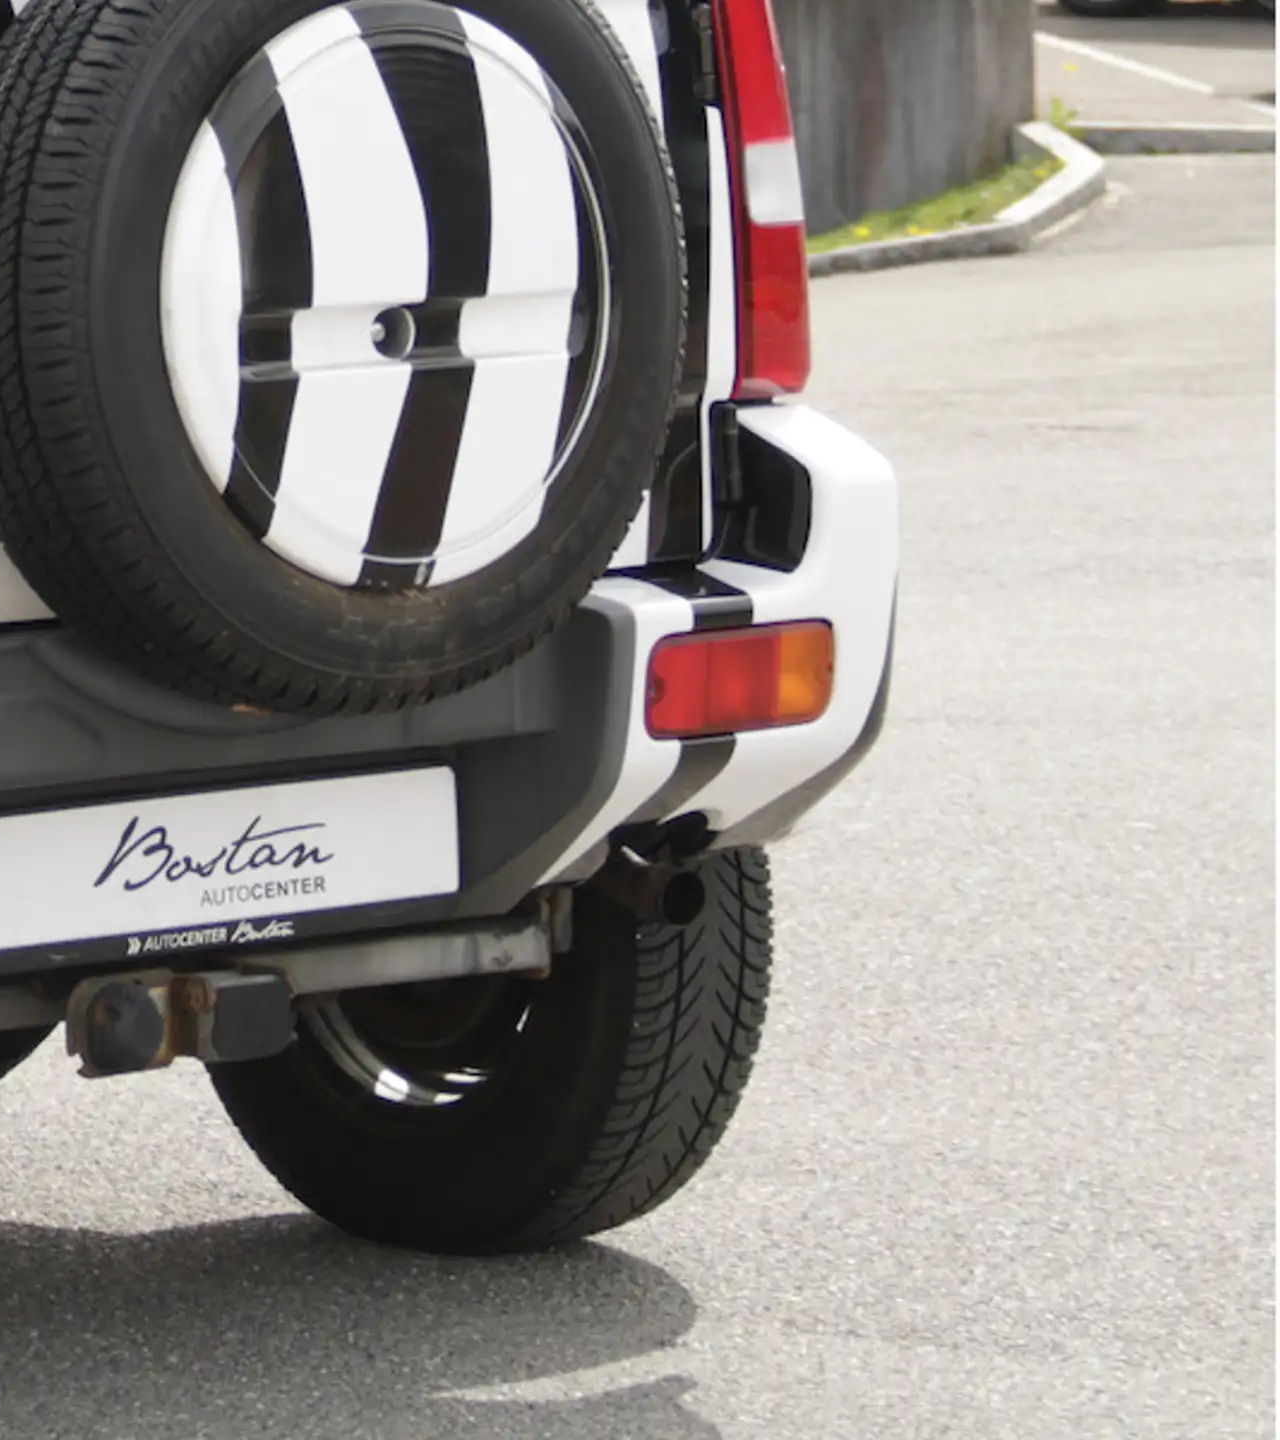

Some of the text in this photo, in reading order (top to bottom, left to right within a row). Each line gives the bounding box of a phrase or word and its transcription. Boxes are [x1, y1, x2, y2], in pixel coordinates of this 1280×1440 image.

[92, 814, 336, 892] Bostan
[198, 875, 327, 909] AUTOCENTER
[143, 926, 228, 952] AUTOCENTER
